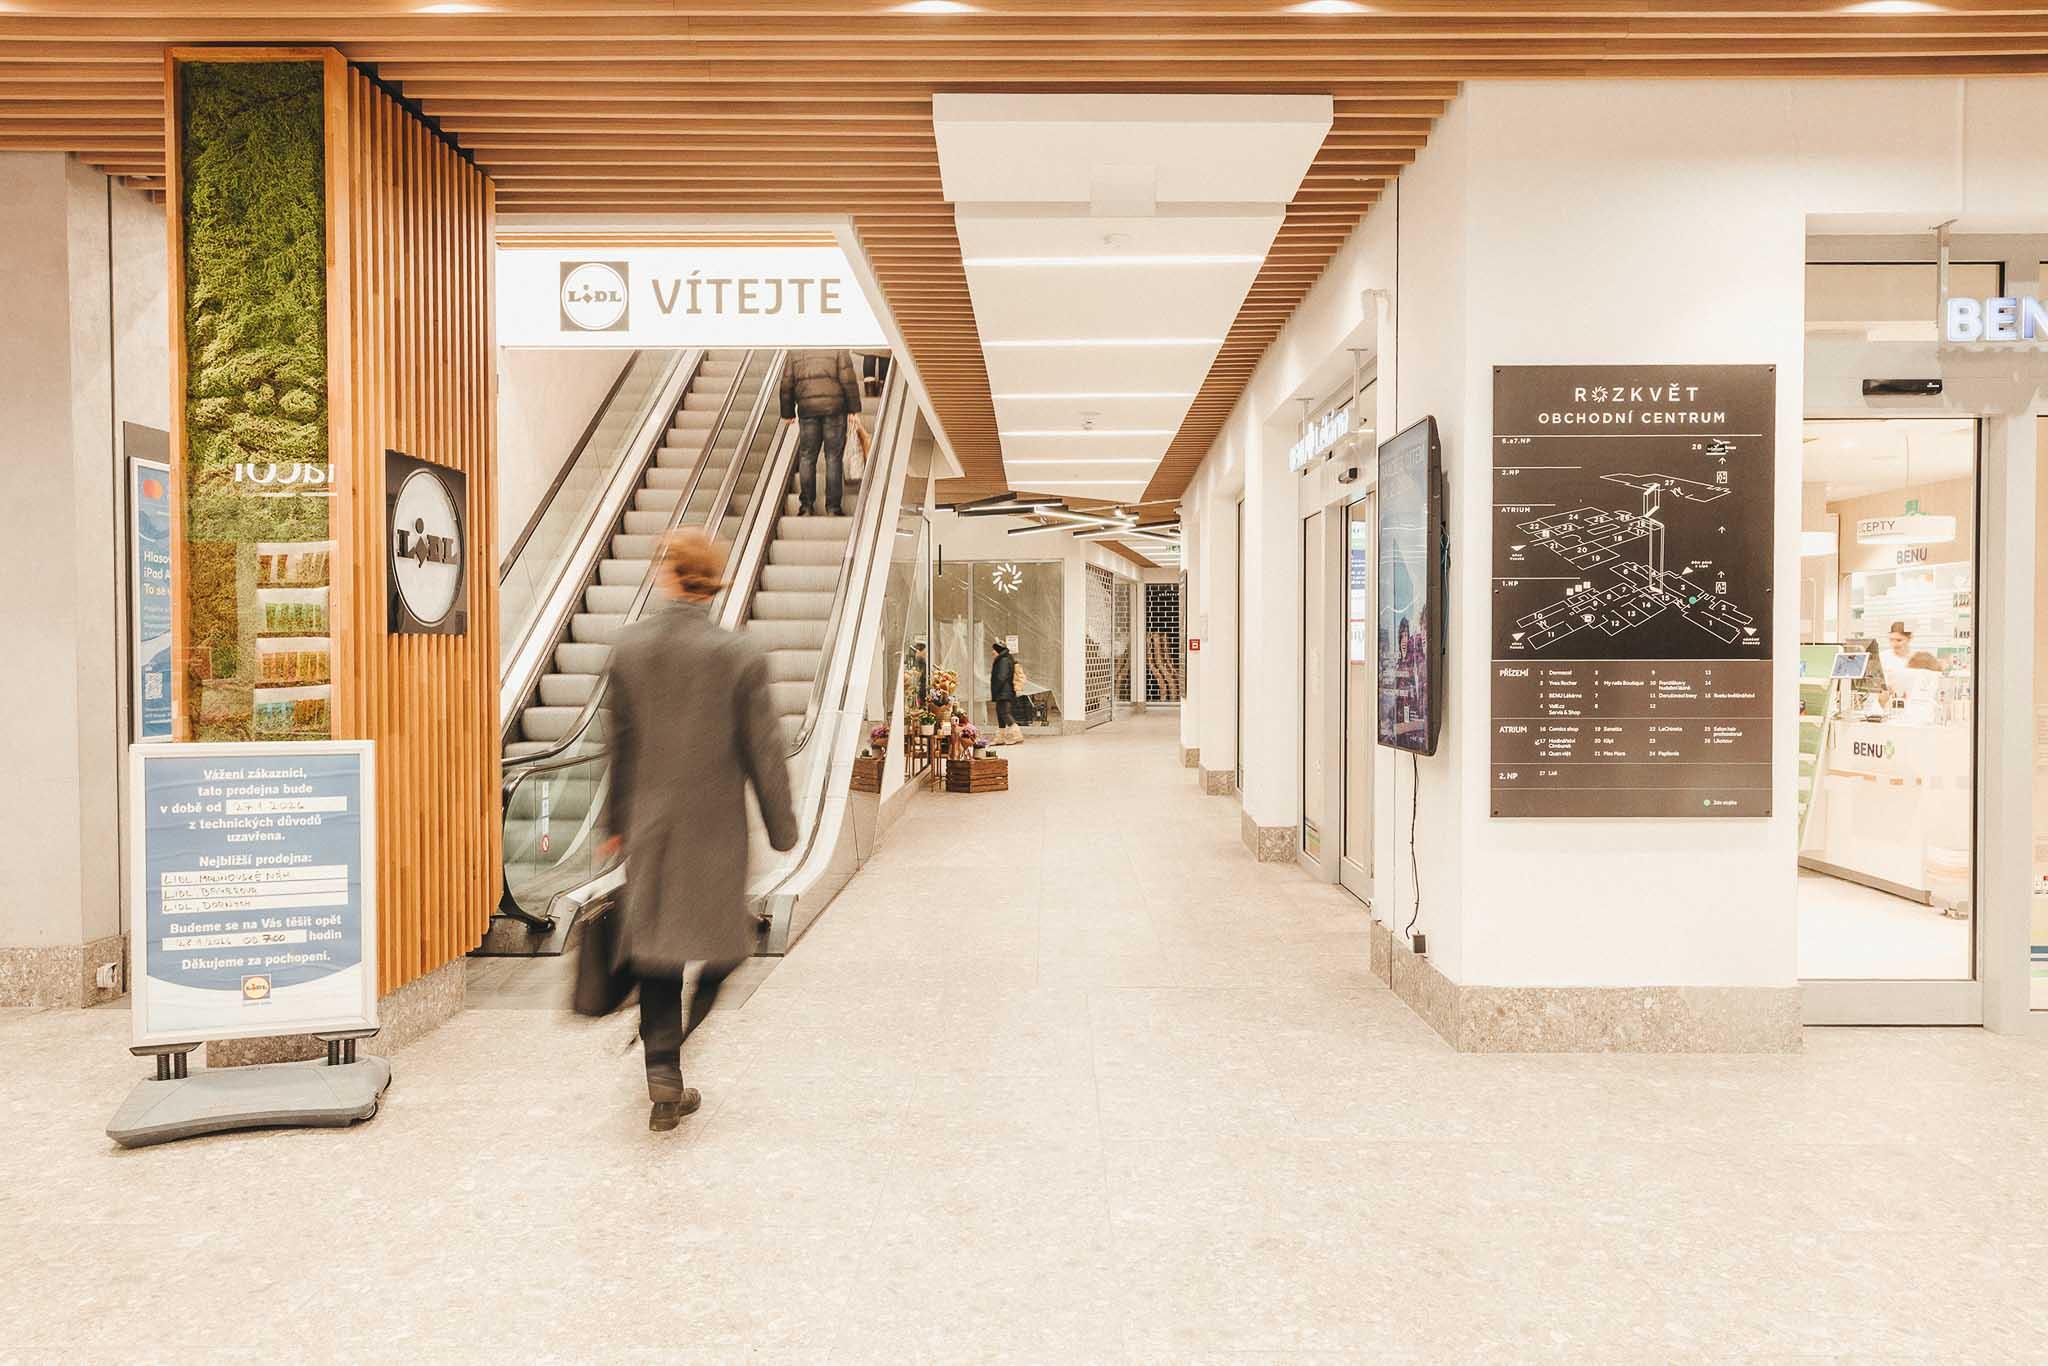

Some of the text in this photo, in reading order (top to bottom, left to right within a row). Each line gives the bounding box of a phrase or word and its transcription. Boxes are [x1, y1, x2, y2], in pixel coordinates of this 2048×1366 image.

[652, 269, 842, 315] VÍTEJTE
[1538, 410, 1726, 424] OBCHODNÍ CENTRUM
[1896, 548, 1928, 564] BENU
[1499, 668, 1529, 677] PŘÍZEMÍ
[1499, 726, 1528, 734] ATRIUM
[1853, 741, 1883, 758] BENU
[204, 767, 244, 780] Vážení
[198, 784, 313, 797] tato prodejna bude
[160, 802, 222, 814] v době od
[189, 814, 322, 831] z technických důvodů
[227, 831, 286, 842] uzavřena.
[199, 854, 313, 869] Nejbližší prodejna:
[170, 914, 342, 934] Budeme se na Vás těšit opět
[309, 930, 342, 942] hodin
[182, 950, 331, 971] Děkujeme za pochopení.
